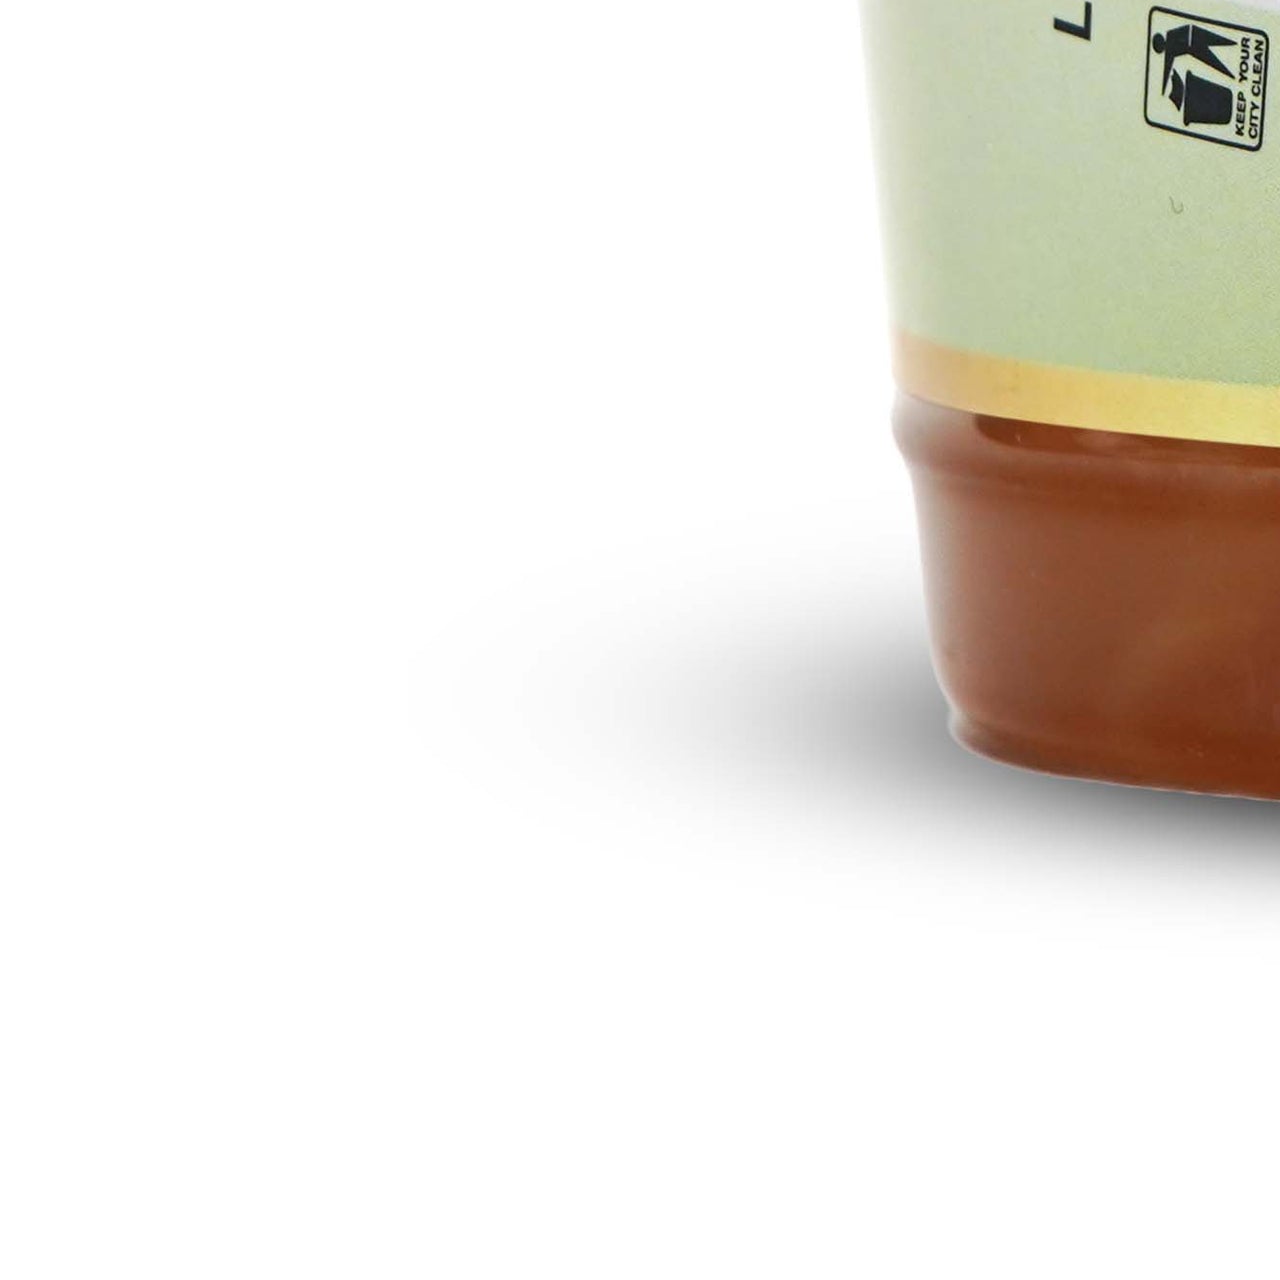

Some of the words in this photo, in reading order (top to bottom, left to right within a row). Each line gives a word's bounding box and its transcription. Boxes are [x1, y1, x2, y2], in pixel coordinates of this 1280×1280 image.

[1238, 36, 1251, 84] YOUR
[1251, 39, 1264, 97] CLEAN
[1235, 90, 1247, 137] KEEP
[1248, 101, 1260, 139] CITY
